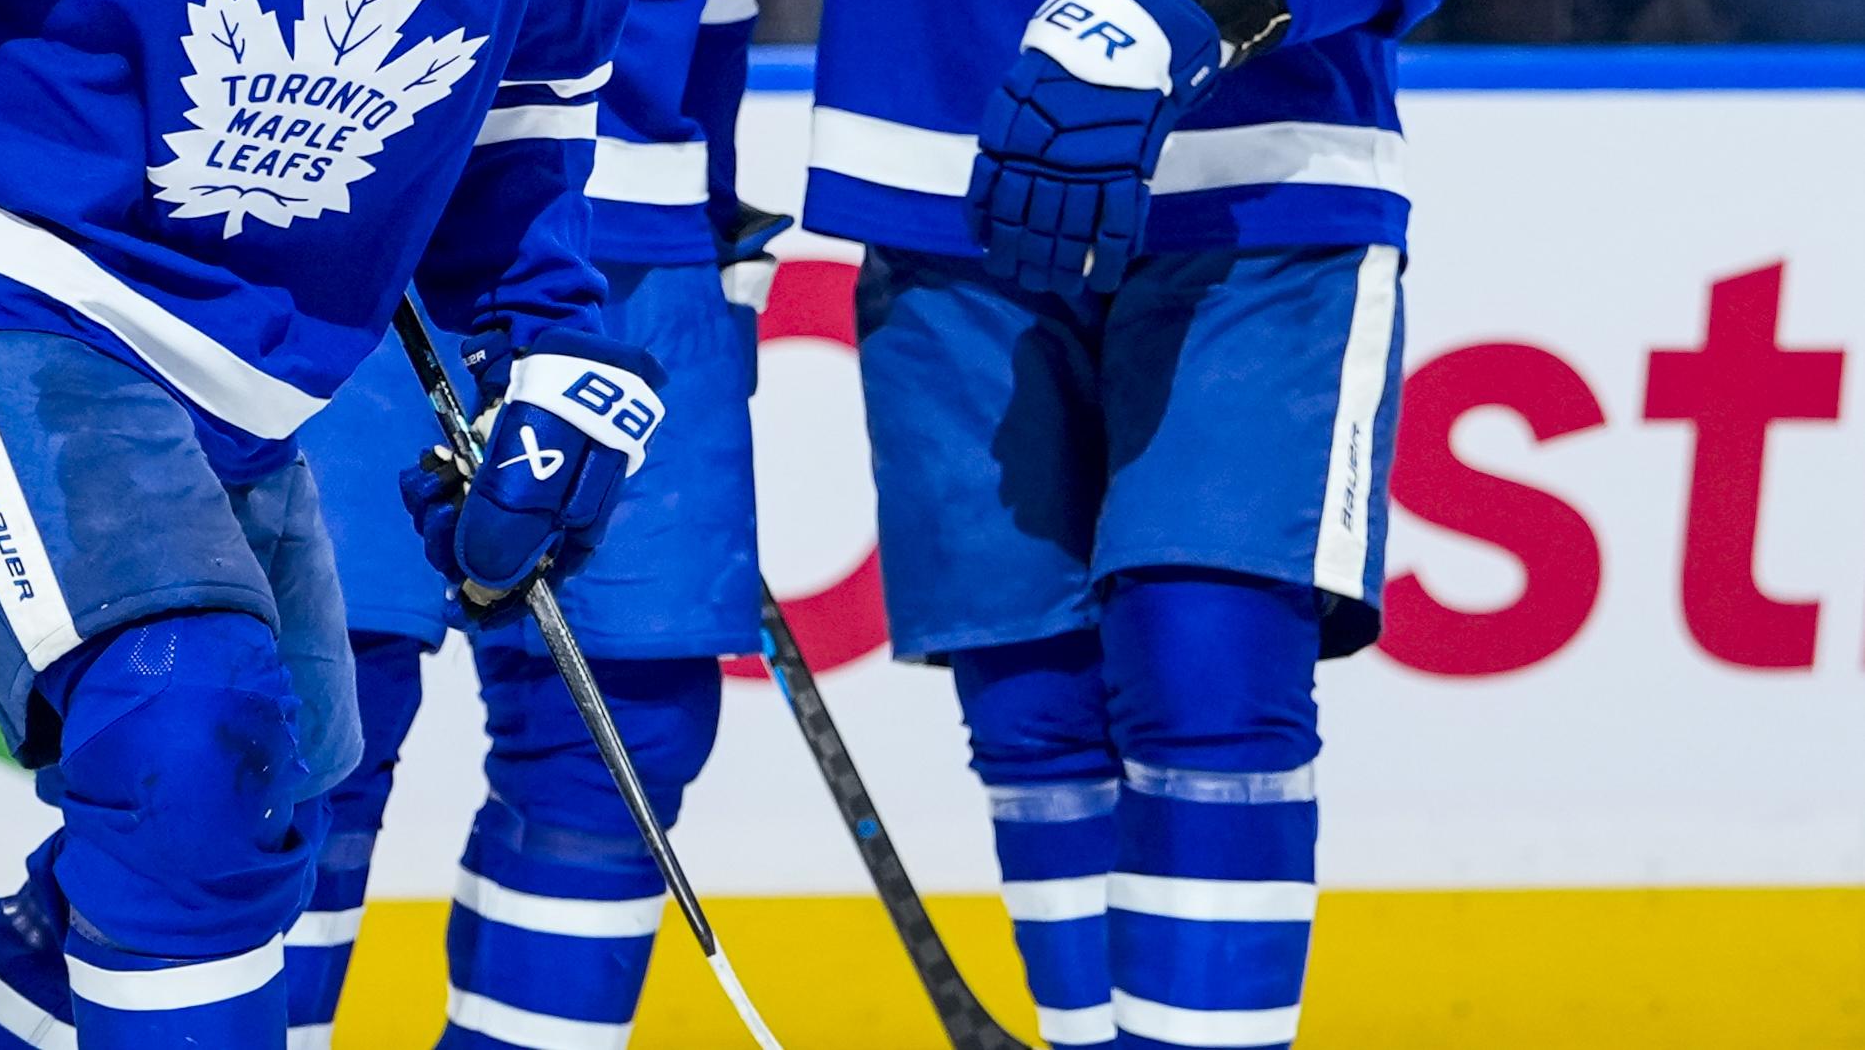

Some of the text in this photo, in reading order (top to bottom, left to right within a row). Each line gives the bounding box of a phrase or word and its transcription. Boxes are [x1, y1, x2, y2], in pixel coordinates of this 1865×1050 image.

[221, 73, 398, 132] TORONTO
[226, 108, 357, 153] MAPLE
[205, 140, 333, 182] LEAFS
